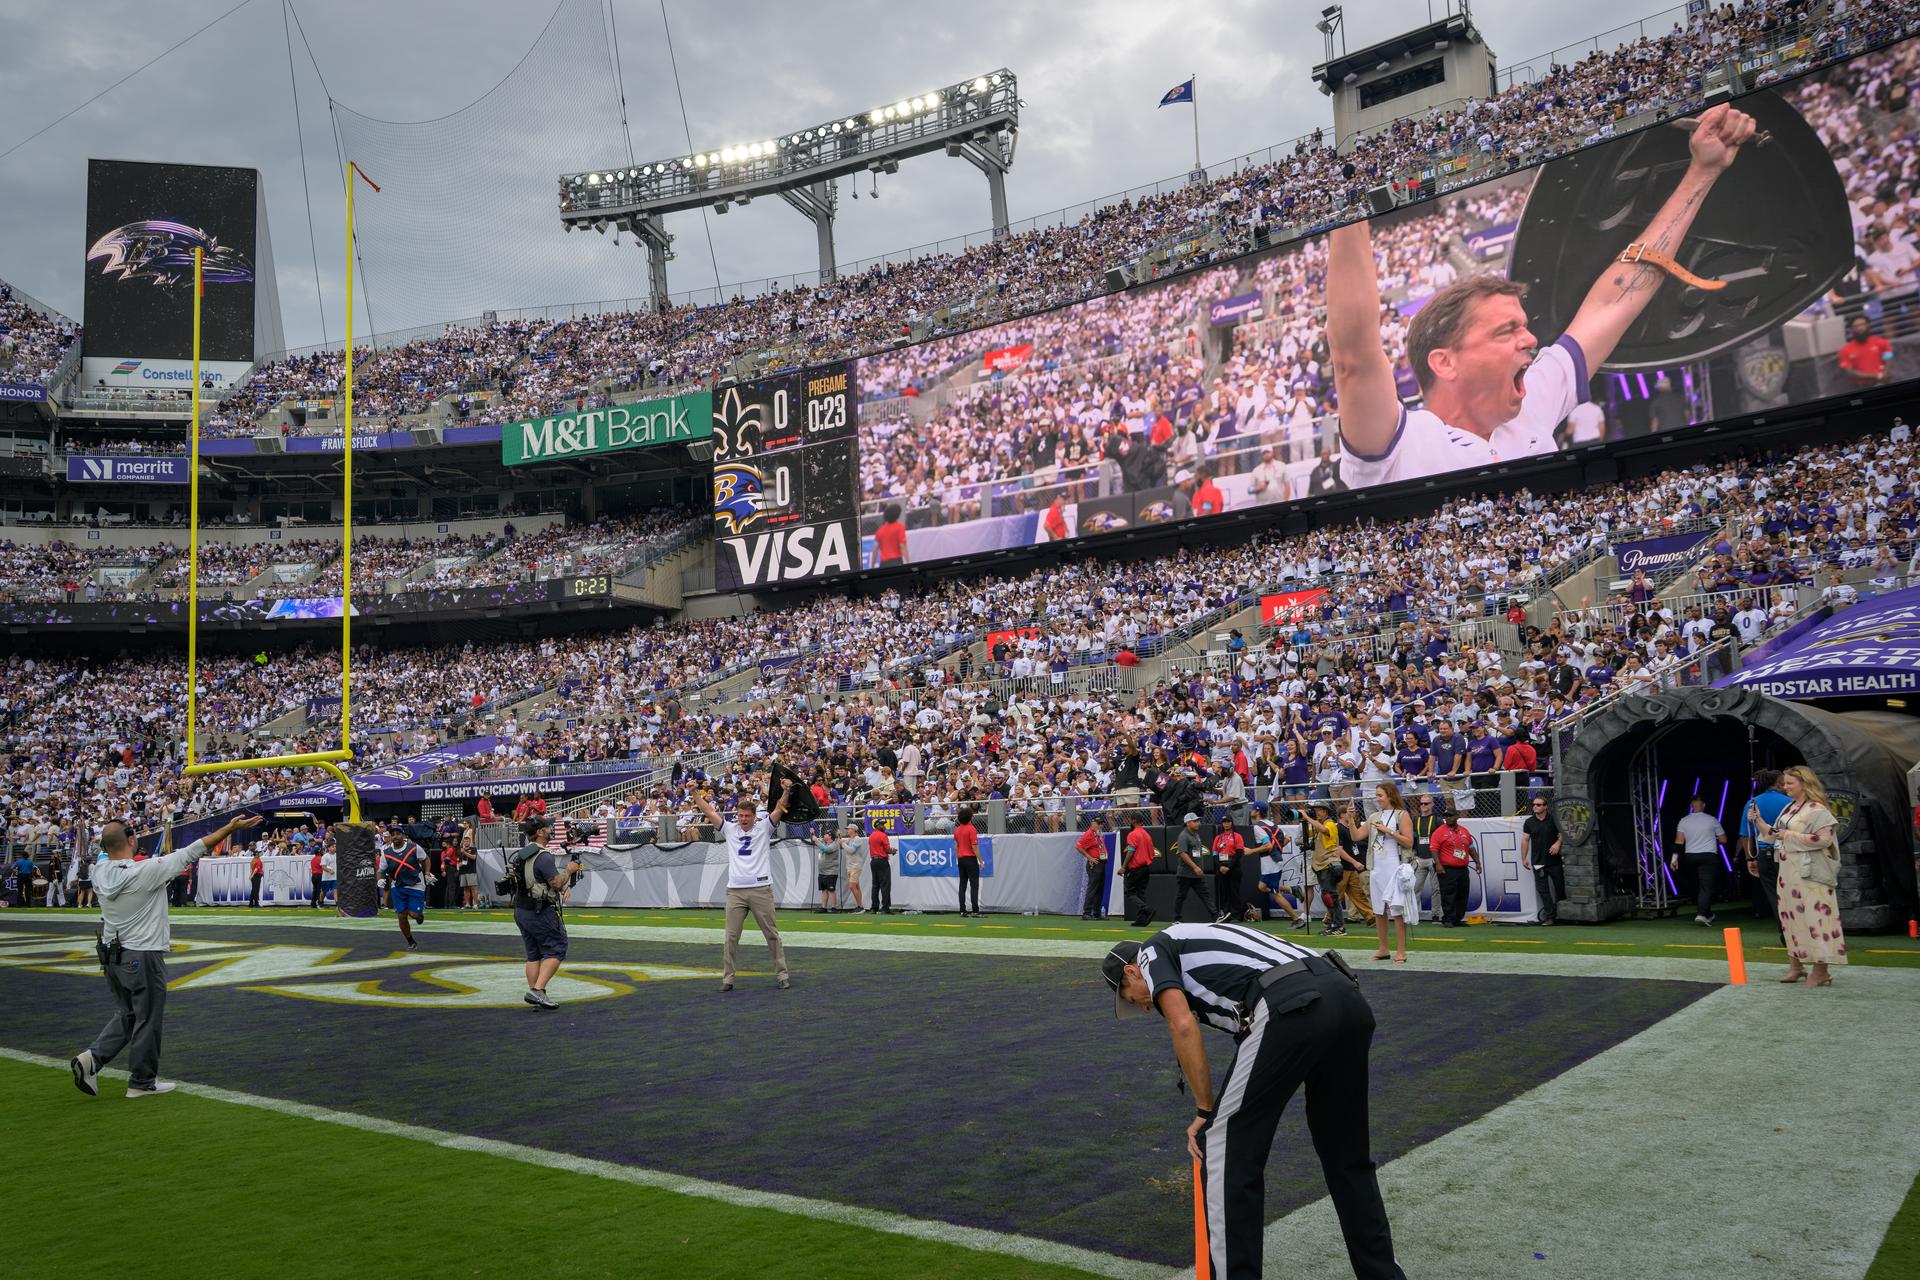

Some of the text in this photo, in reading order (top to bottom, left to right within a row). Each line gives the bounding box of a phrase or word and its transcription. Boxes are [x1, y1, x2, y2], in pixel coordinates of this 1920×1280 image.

[142, 367, 223, 382] Constelltion
[808, 373, 848, 397] PREGAME
[774, 389, 788, 430] 0
[807, 394, 846, 433] 0:23
[520, 400, 692, 460] M&T Bank
[321, 436, 378, 450] #RAVESFLOCK
[116, 459, 174, 475] merritt
[775, 466, 790, 507] 0
[722, 522, 851, 585] VISA
[574, 577, 608, 596] 0:23
[1743, 616, 1751, 629] 0
[1062, 639, 1072, 648] 68
[1553, 674, 1561, 684] 4
[1743, 673, 1916, 696] MEDSTAR HEALTH
[1222, 684, 1232, 692] 14
[1161, 739, 1175, 751] 22
[1263, 766, 1272, 779] 4
[424, 789, 443, 800] BUD
[444, 787, 472, 798] LIGHT
[538, 780, 566, 793] CLUB
[279, 797, 328, 806] MEDSTAR HEALTH
[866, 808, 900, 818] CHEESE
[738, 836, 752, 856] 2
[918, 849, 947, 866] CBS
[211, 861, 275, 901] WHIE
